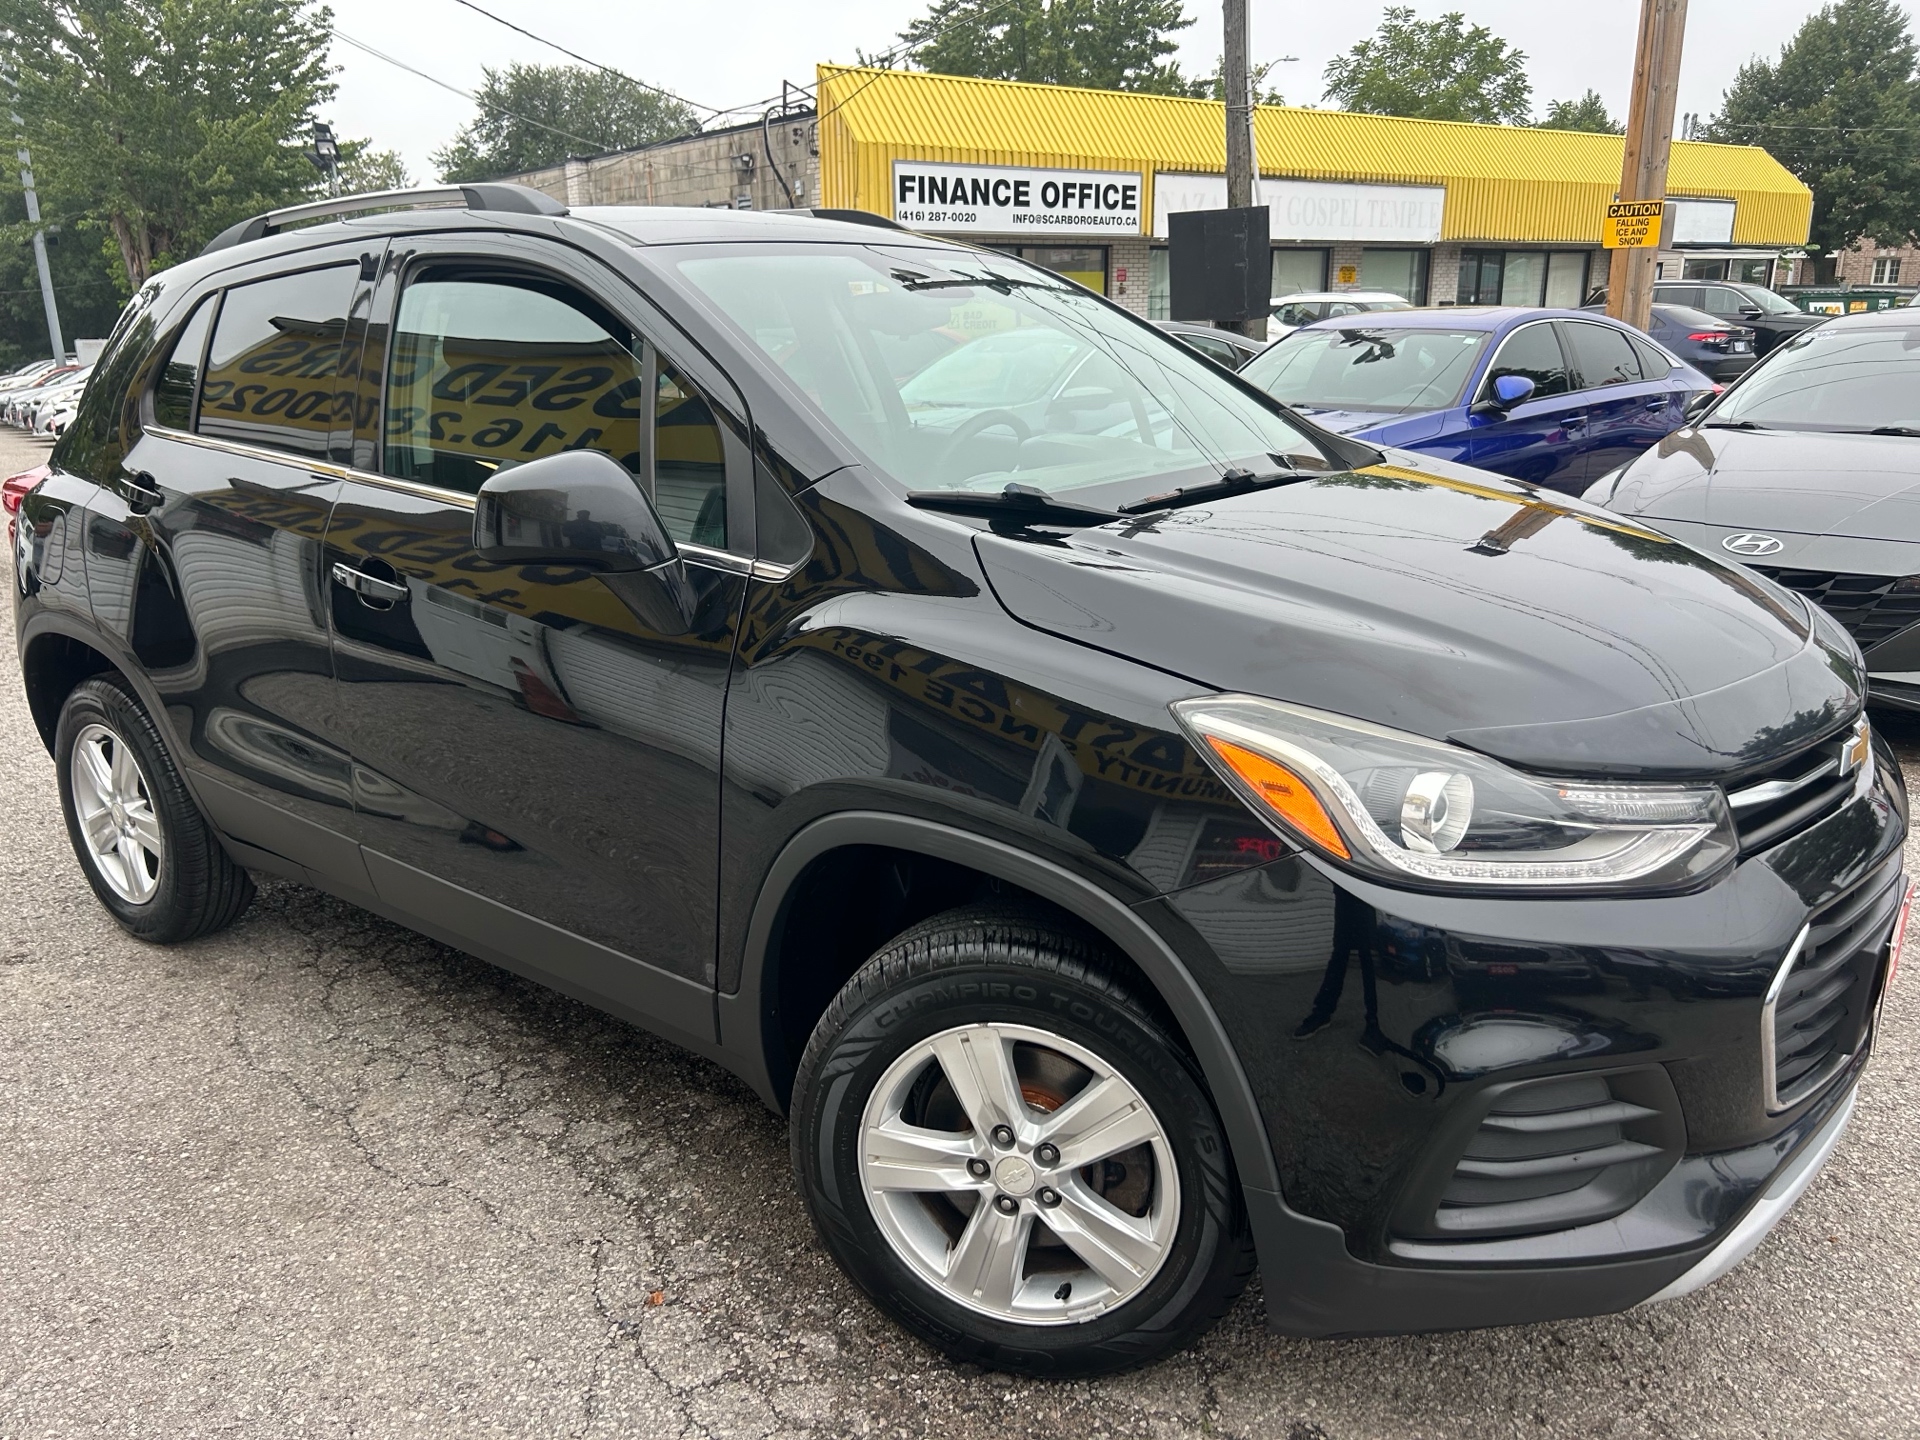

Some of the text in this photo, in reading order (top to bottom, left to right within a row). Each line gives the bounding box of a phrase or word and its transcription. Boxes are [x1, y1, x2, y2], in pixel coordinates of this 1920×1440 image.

[899, 174, 1137, 211] FINANCE OFFICE
[898, 210, 977, 223] (416) 287-0020
[1288, 194, 1365, 228] GOSPEL
[1367, 198, 1441, 230] TEMPLE
[1609, 203, 1660, 217] CAUTION
[1012, 213, 1138, 227] INFO@SCARBOROEAUTO.CA
[1616, 217, 1650, 228] FALLING
[1615, 227, 1648, 237] ICE AND
[1618, 237, 1644, 246] SNOW
[1049, 991, 1183, 1092] TOURING
